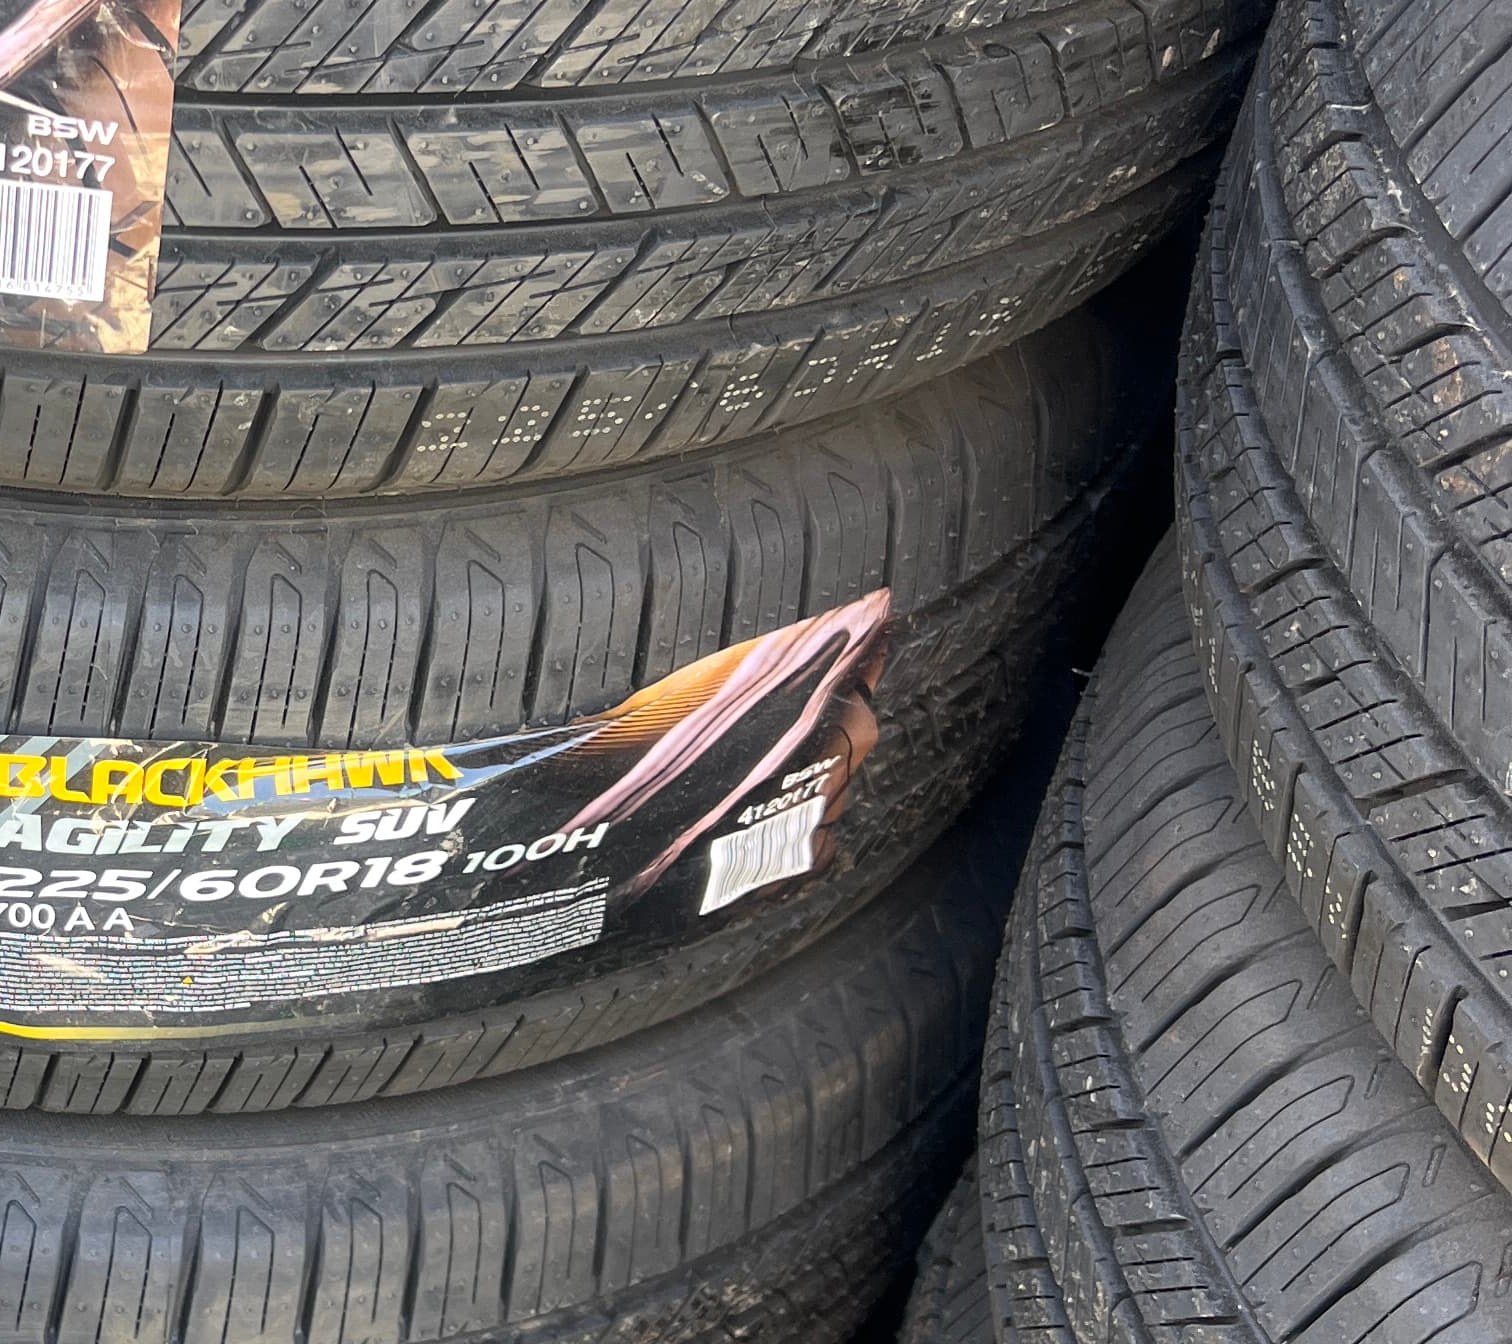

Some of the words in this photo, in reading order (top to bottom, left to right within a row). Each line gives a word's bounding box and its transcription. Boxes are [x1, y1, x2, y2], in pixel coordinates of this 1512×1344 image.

[27, 114, 118, 146] BSW
[334, 798, 476, 846] SUV
[464, 821, 610, 876] 100H
[64, 906, 96, 932] A
[102, 906, 135, 932] A
